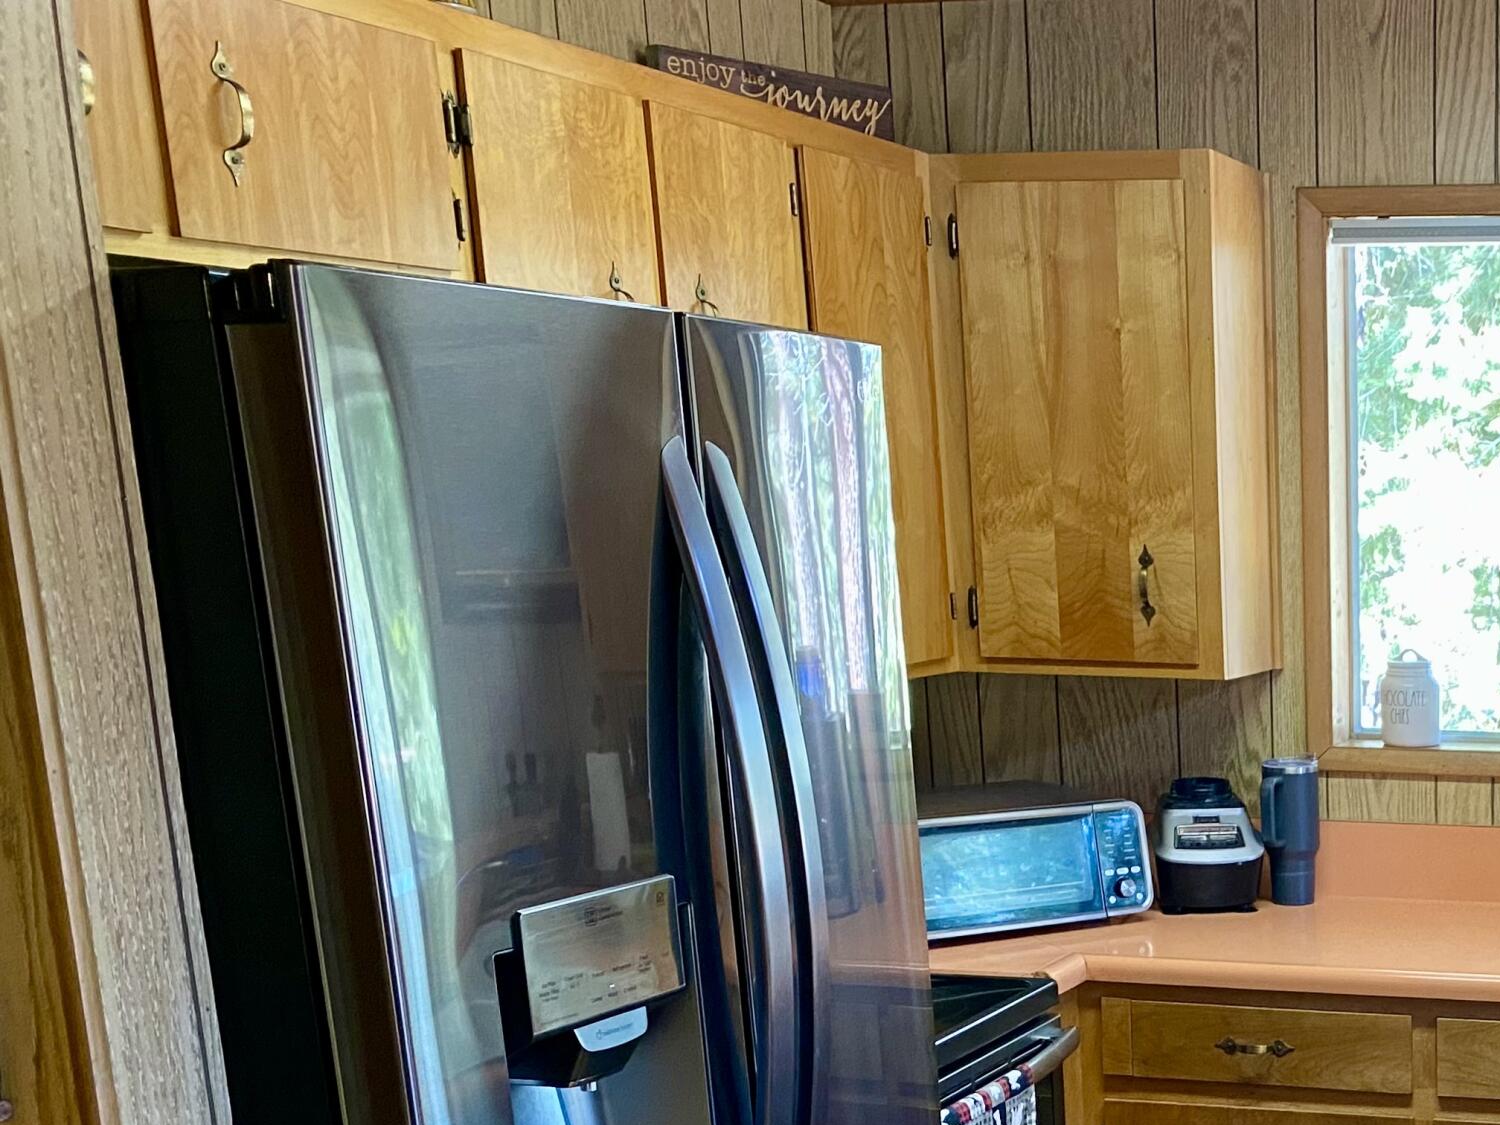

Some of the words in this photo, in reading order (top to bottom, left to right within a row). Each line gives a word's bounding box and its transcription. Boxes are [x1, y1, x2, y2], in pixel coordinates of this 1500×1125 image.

[667, 56, 736, 88] enjoy
[741, 69, 765, 86] the
[740, 70, 892, 136] journey
